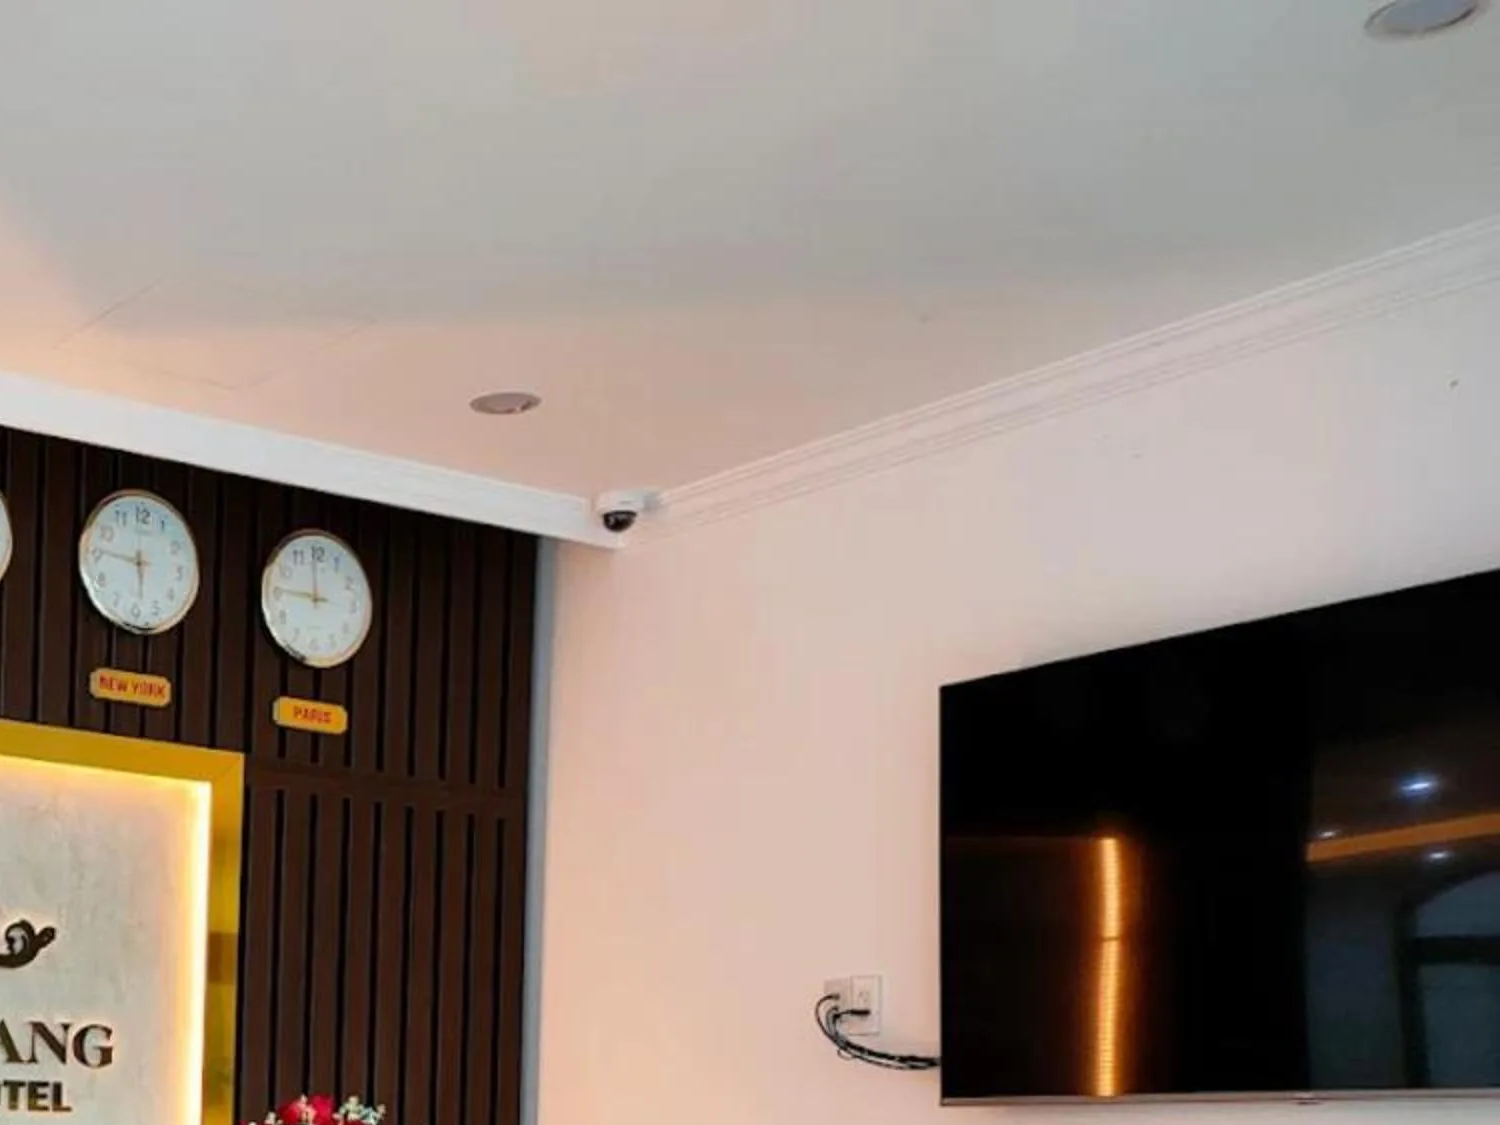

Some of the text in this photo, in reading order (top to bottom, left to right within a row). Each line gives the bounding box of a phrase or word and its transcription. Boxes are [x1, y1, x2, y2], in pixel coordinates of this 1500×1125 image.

[115, 509, 127, 527] 11
[136, 505, 151, 524] 12
[293, 549, 304, 565] 11
[311, 545, 325, 562] 12
[99, 675, 166, 698] NEW YORK
[293, 705, 333, 724] PARIS
